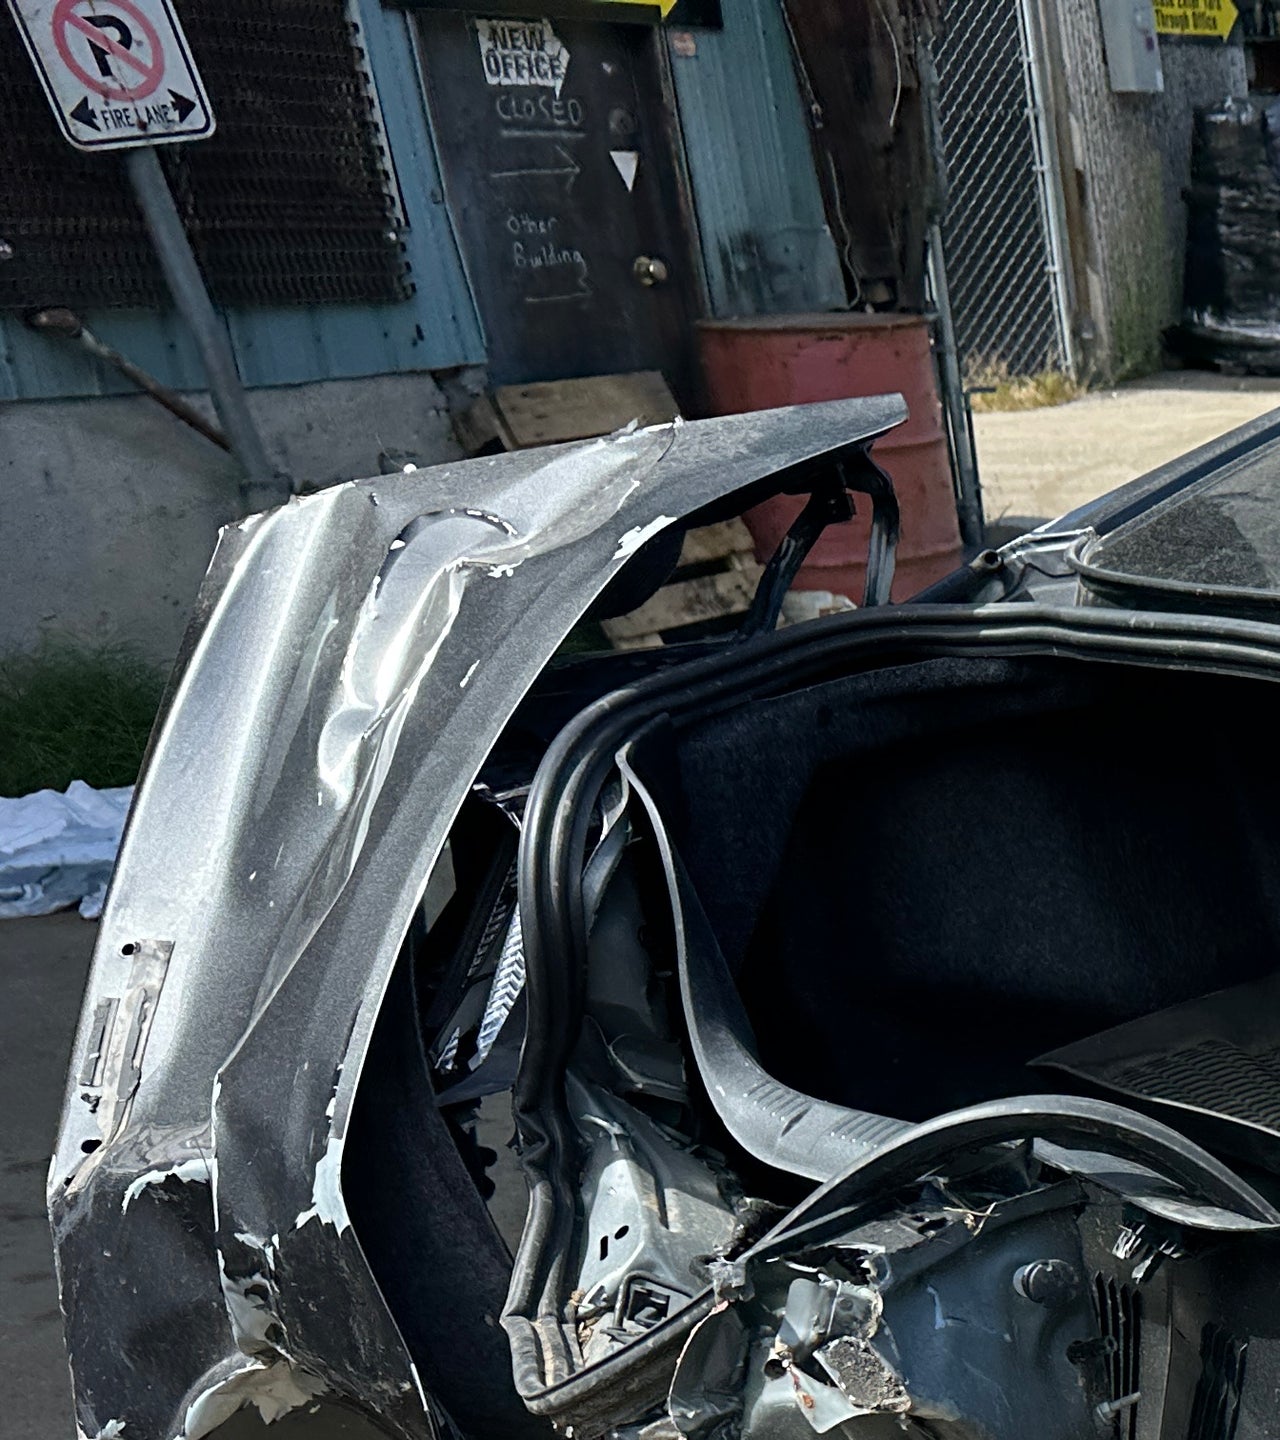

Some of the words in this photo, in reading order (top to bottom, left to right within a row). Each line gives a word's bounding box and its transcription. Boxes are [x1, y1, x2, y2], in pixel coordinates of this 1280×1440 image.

[489, 25, 545, 51] NEW
[484, 51, 564, 80] OFFICE
[100, 107, 136, 131] FIRE
[136, 103, 176, 128] LANE
[506, 212, 558, 234] Other
[513, 241, 588, 277] Building
